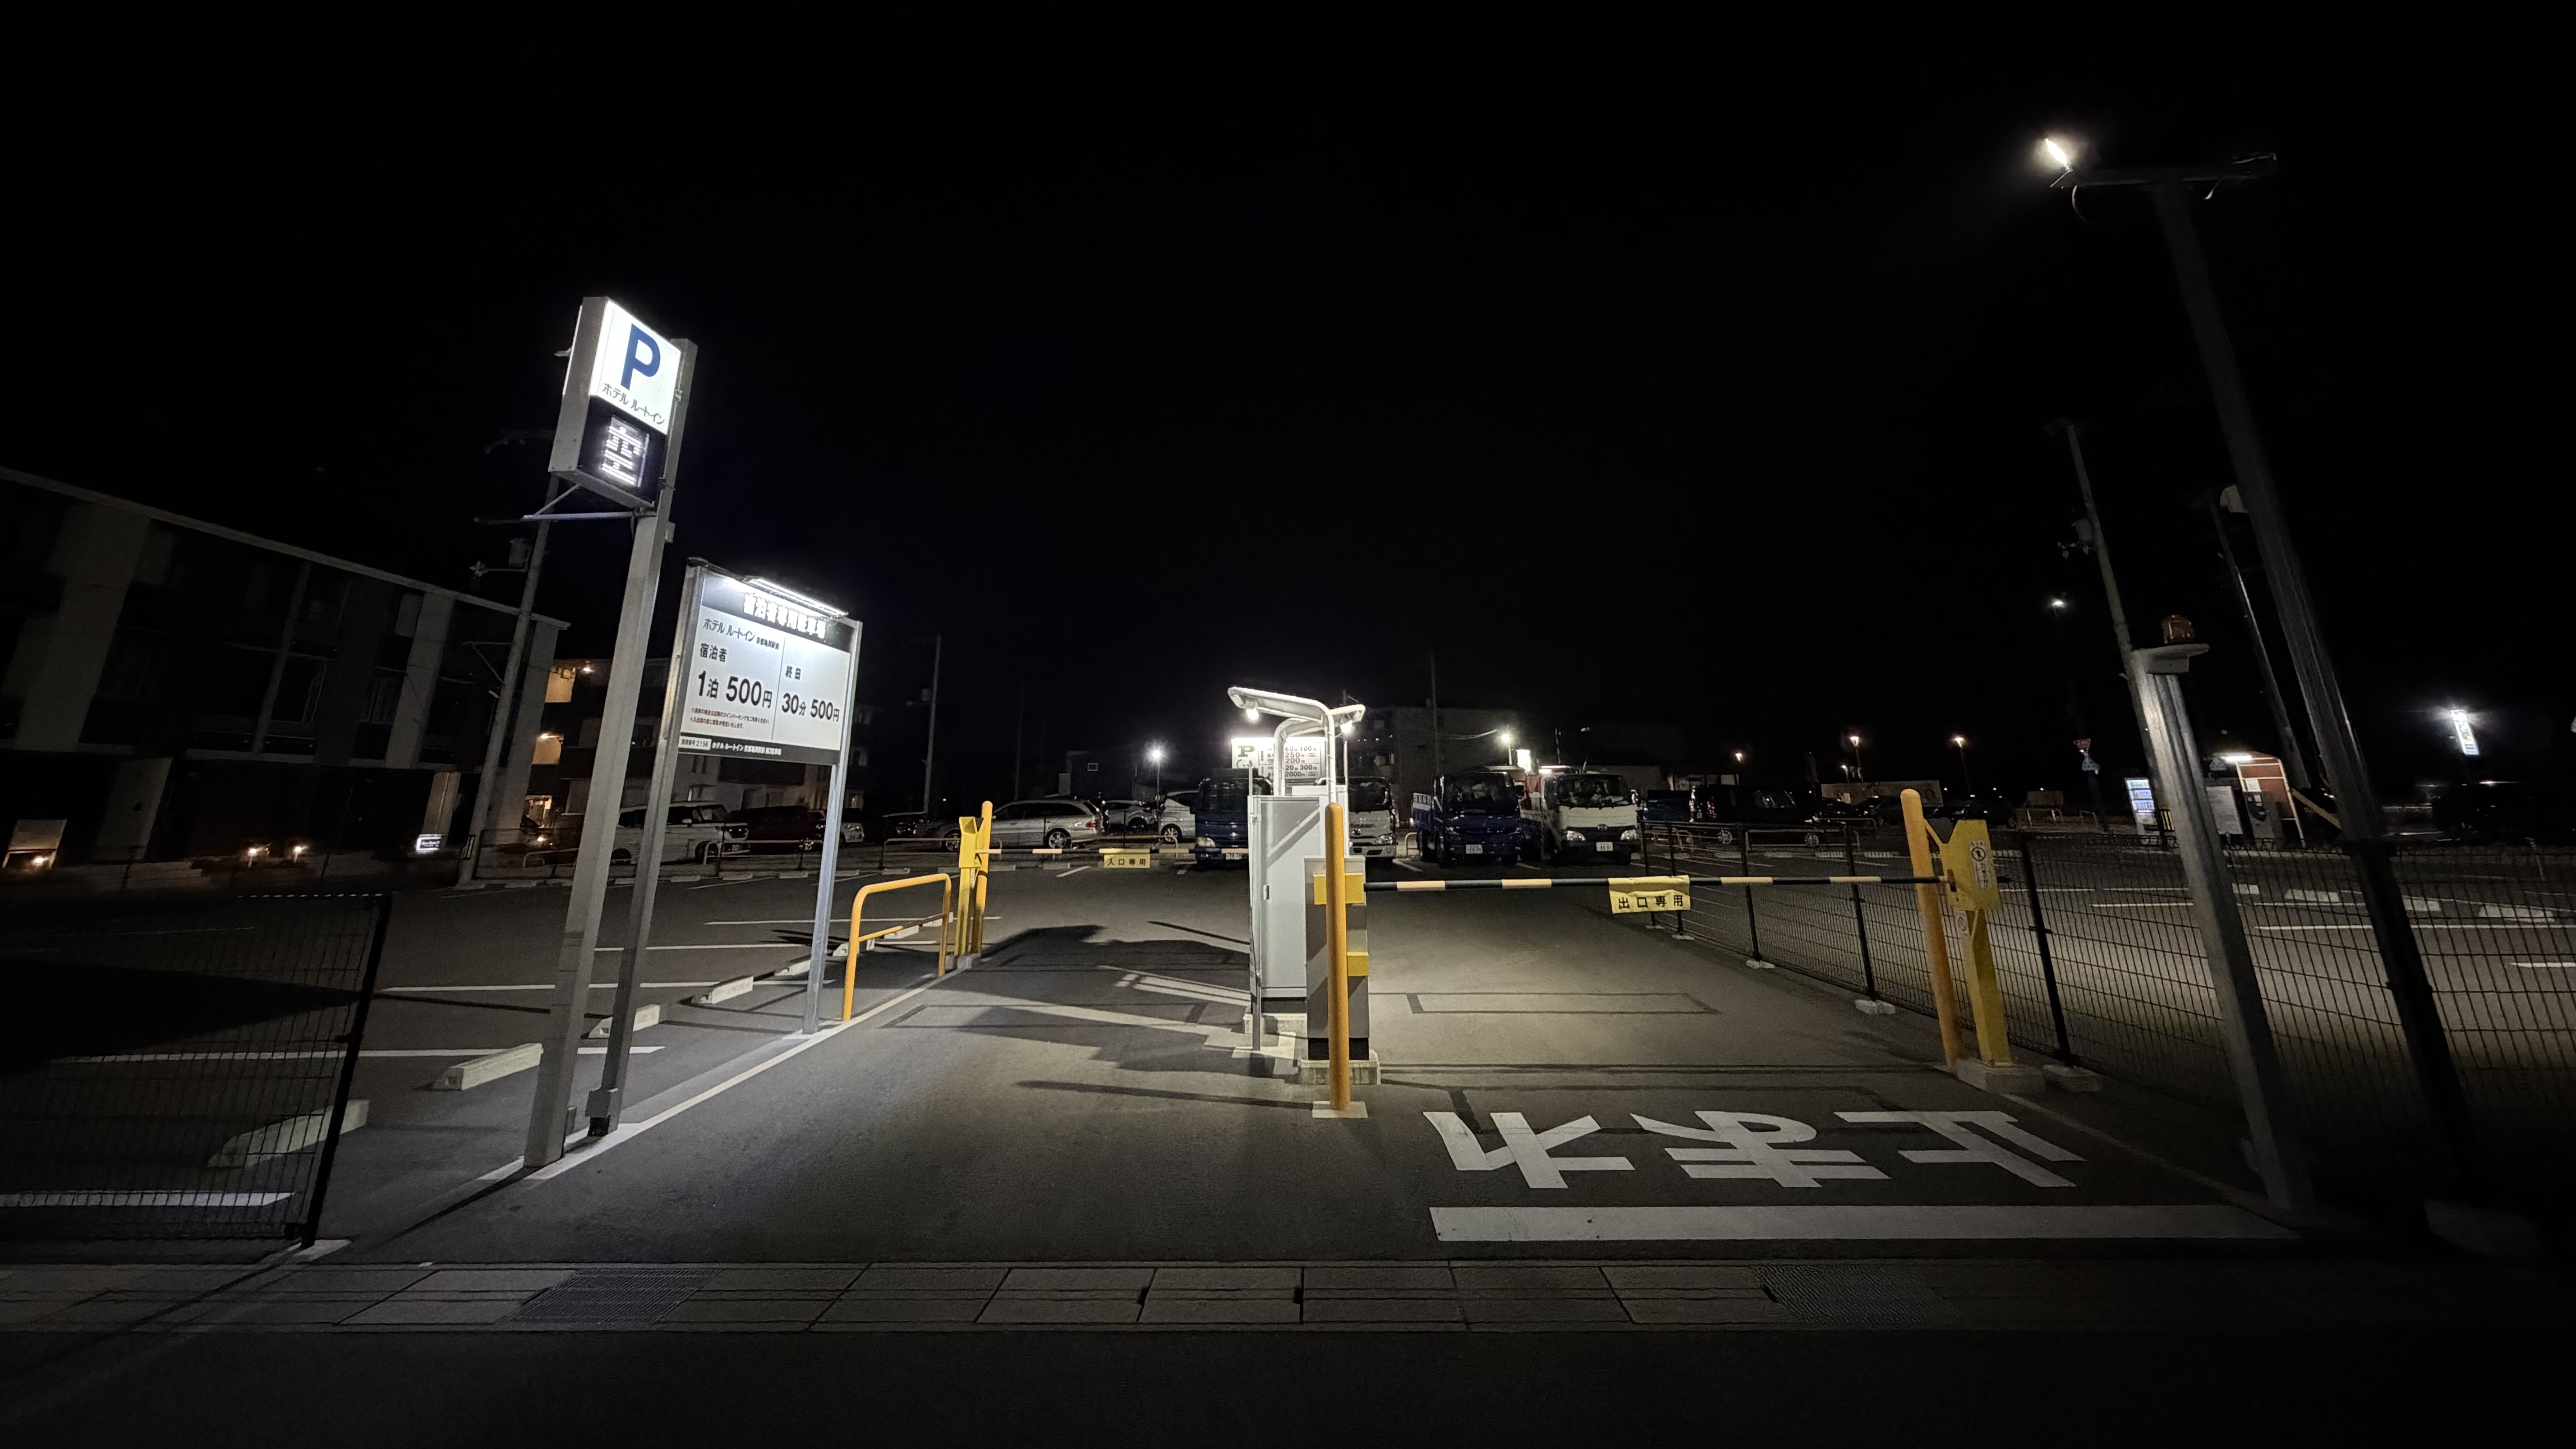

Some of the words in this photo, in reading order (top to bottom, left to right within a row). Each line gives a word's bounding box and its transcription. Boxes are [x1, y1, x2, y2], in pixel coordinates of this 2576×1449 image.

[621, 323, 660, 391] P
[603, 383, 629, 405] ホテル
[630, 399, 665, 424] ルートイン
[602, 426, 641, 484] 空
[703, 618, 725, 633] ホテル
[726, 625, 755, 642] ルートイン
[700, 643, 727, 662] 宿泊者
[785, 665, 801, 680] 終日
[699, 671, 719, 699] 1泊
[726, 676, 773, 708] 500円
[782, 693, 806, 716] 30分
[810, 699, 840, 722] 500円
[1237, 745, 1255, 758] P
[1618, 895, 1683, 910] 出口専用
[1423, 1111, 2088, 1189] 止まれ
